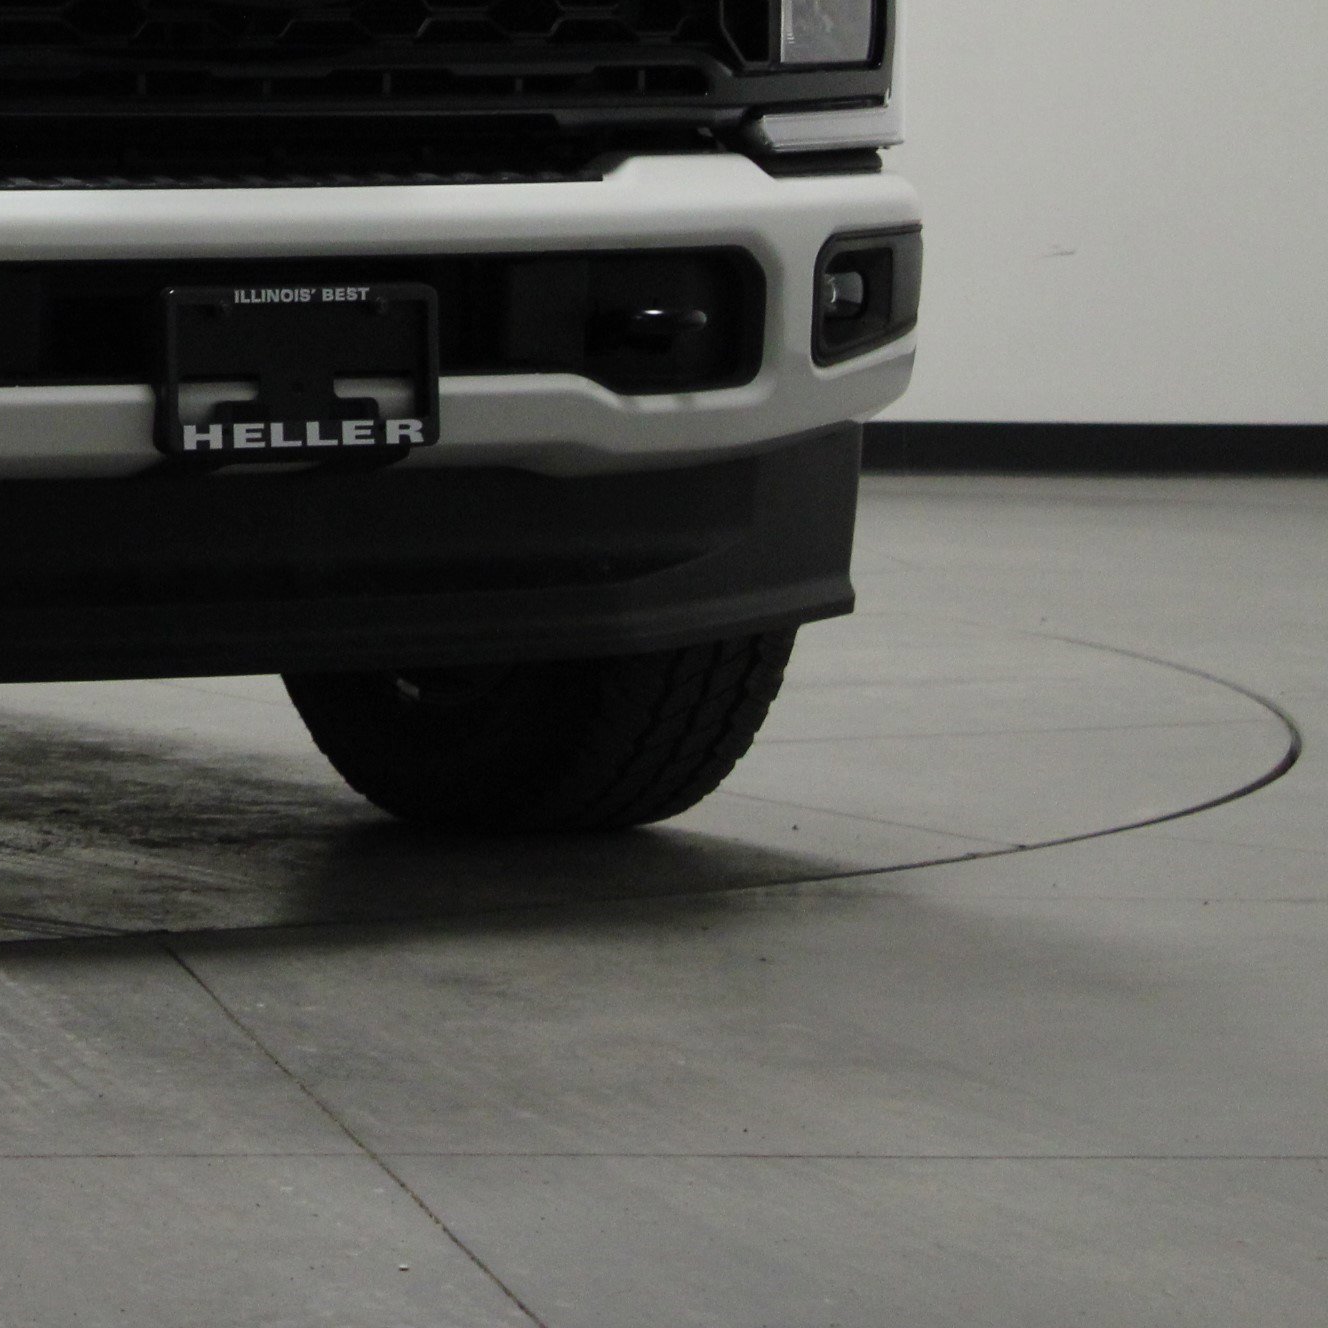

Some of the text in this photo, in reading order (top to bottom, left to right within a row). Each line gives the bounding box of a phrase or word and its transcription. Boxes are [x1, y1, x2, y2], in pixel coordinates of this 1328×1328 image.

[234, 286, 371, 304] ILLINOIS' BEST
[182, 419, 425, 451] HELLER
